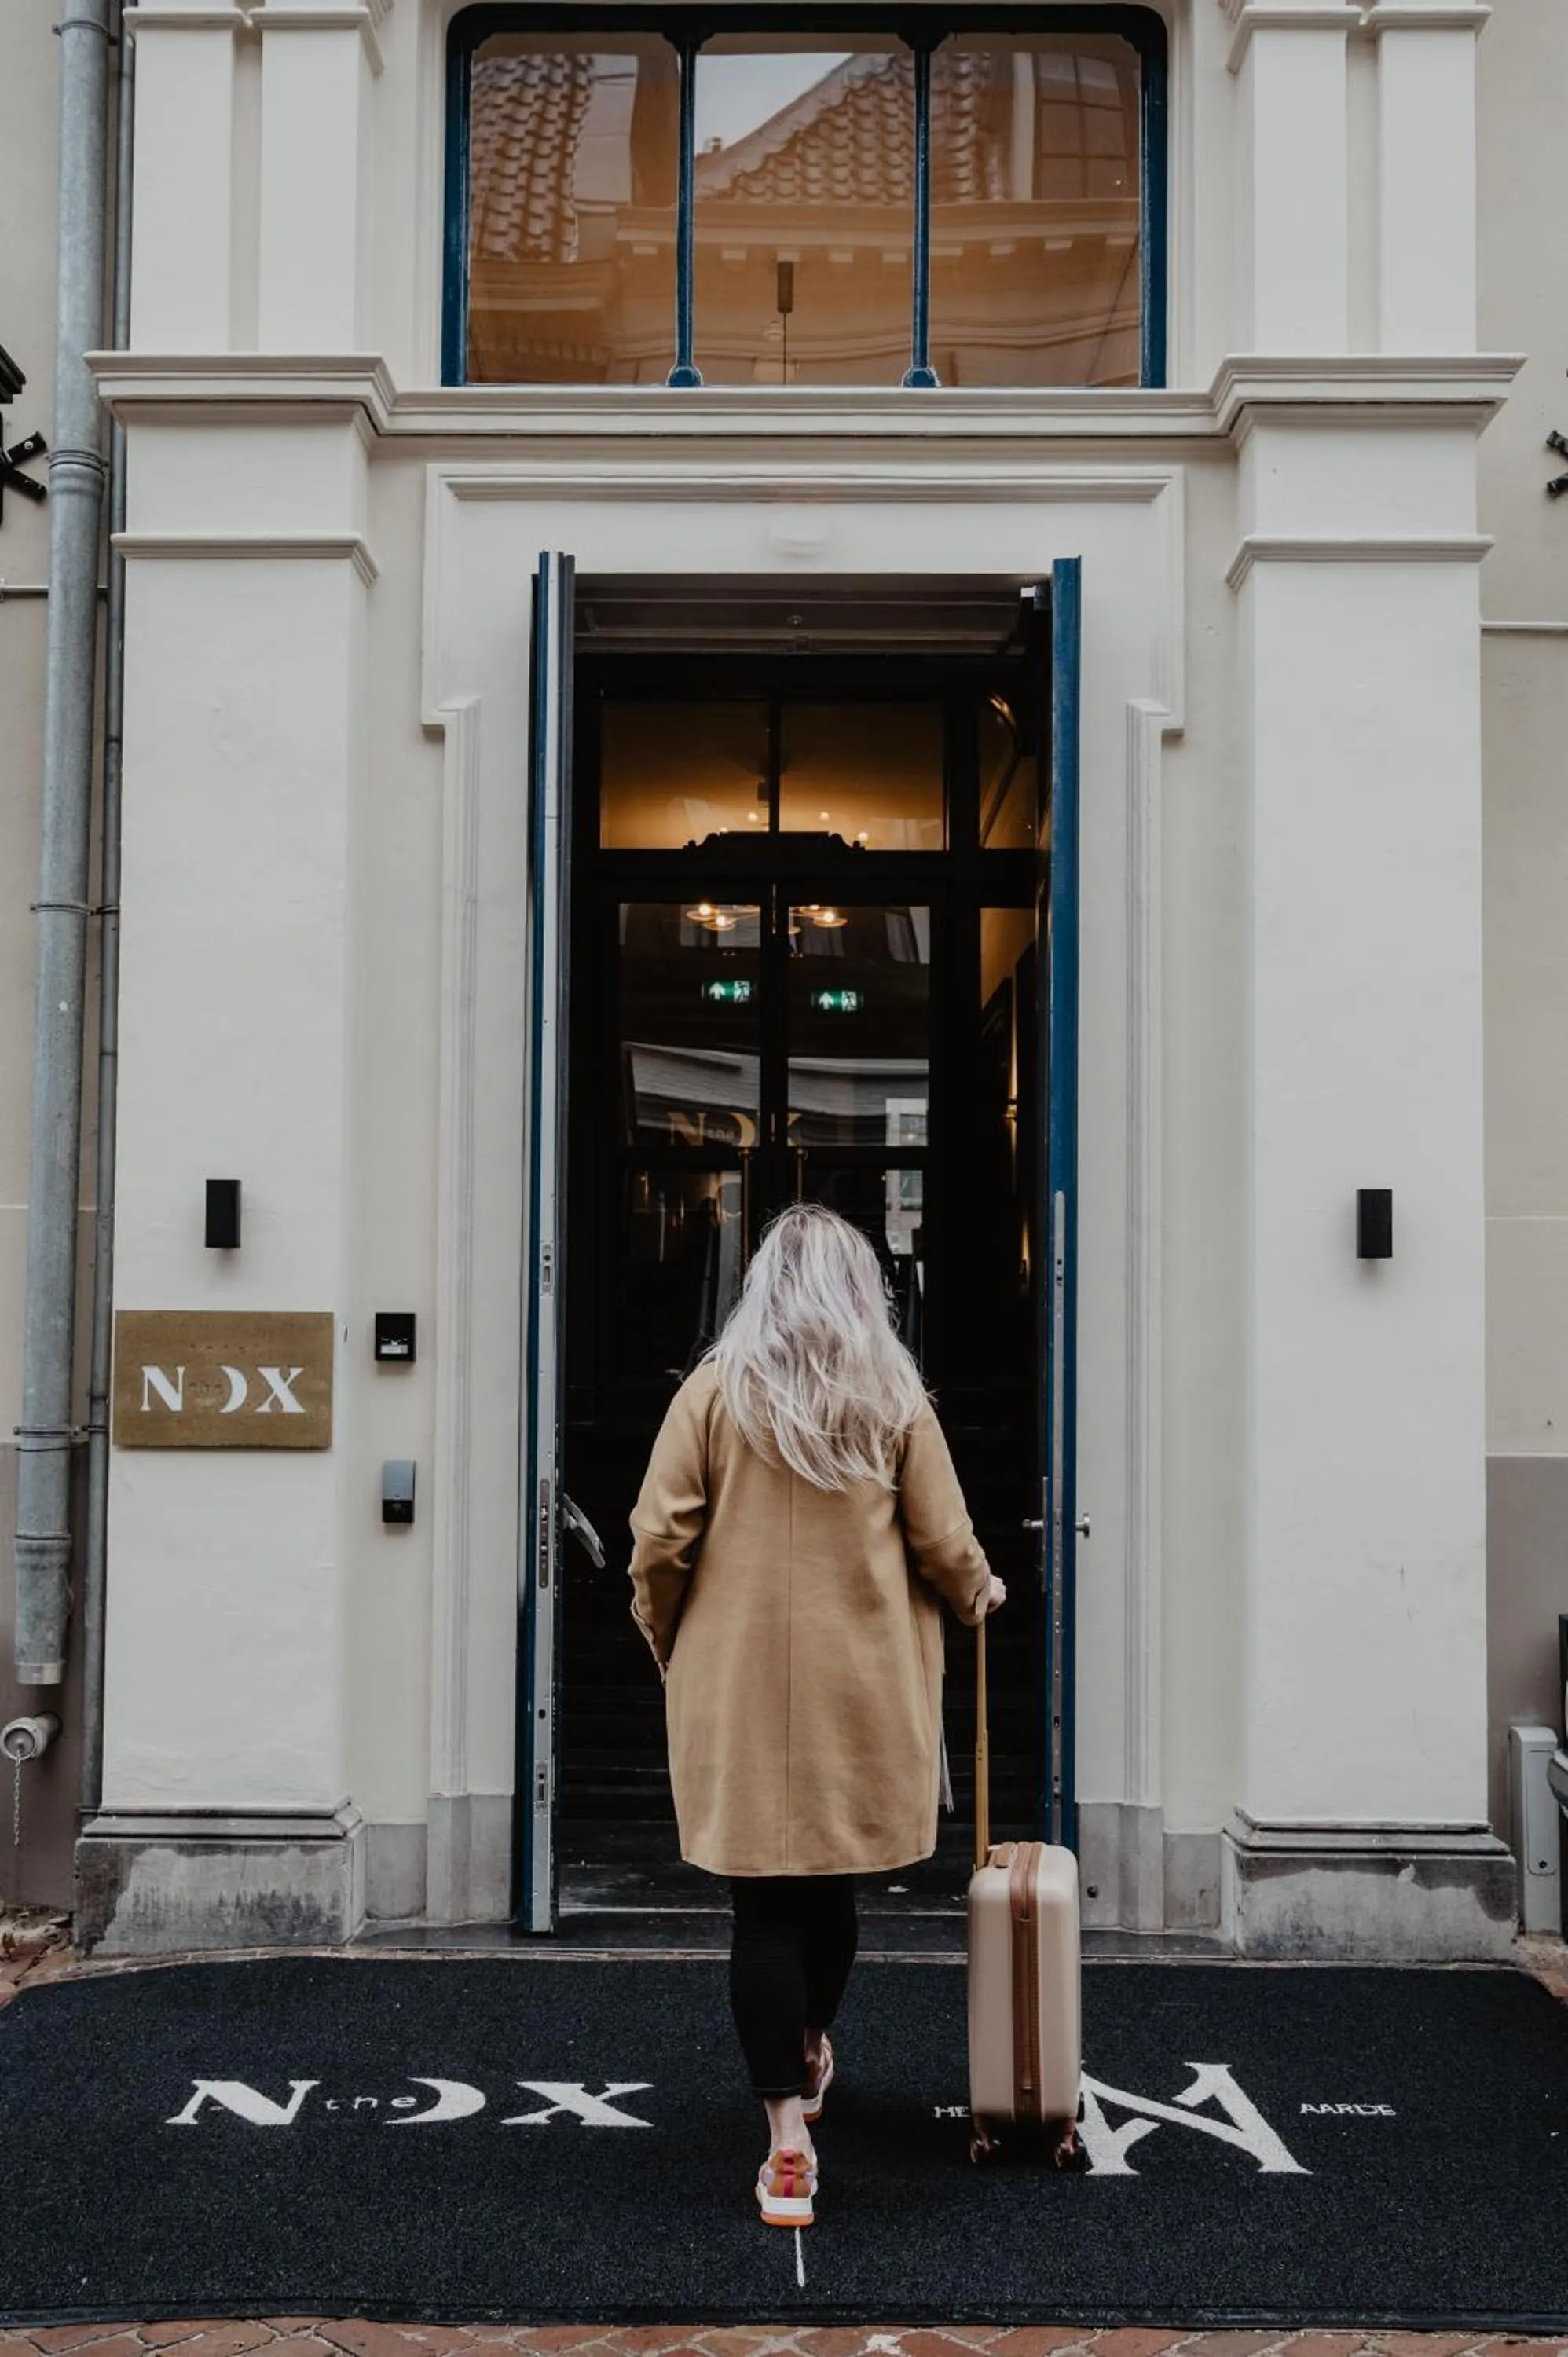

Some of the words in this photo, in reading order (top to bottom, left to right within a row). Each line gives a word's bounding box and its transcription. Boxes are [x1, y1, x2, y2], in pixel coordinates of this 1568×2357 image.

[141, 1365, 306, 1413] NOX
[166, 2078, 654, 2127] NOX
[1299, 2102, 1396, 2116] AARDE
